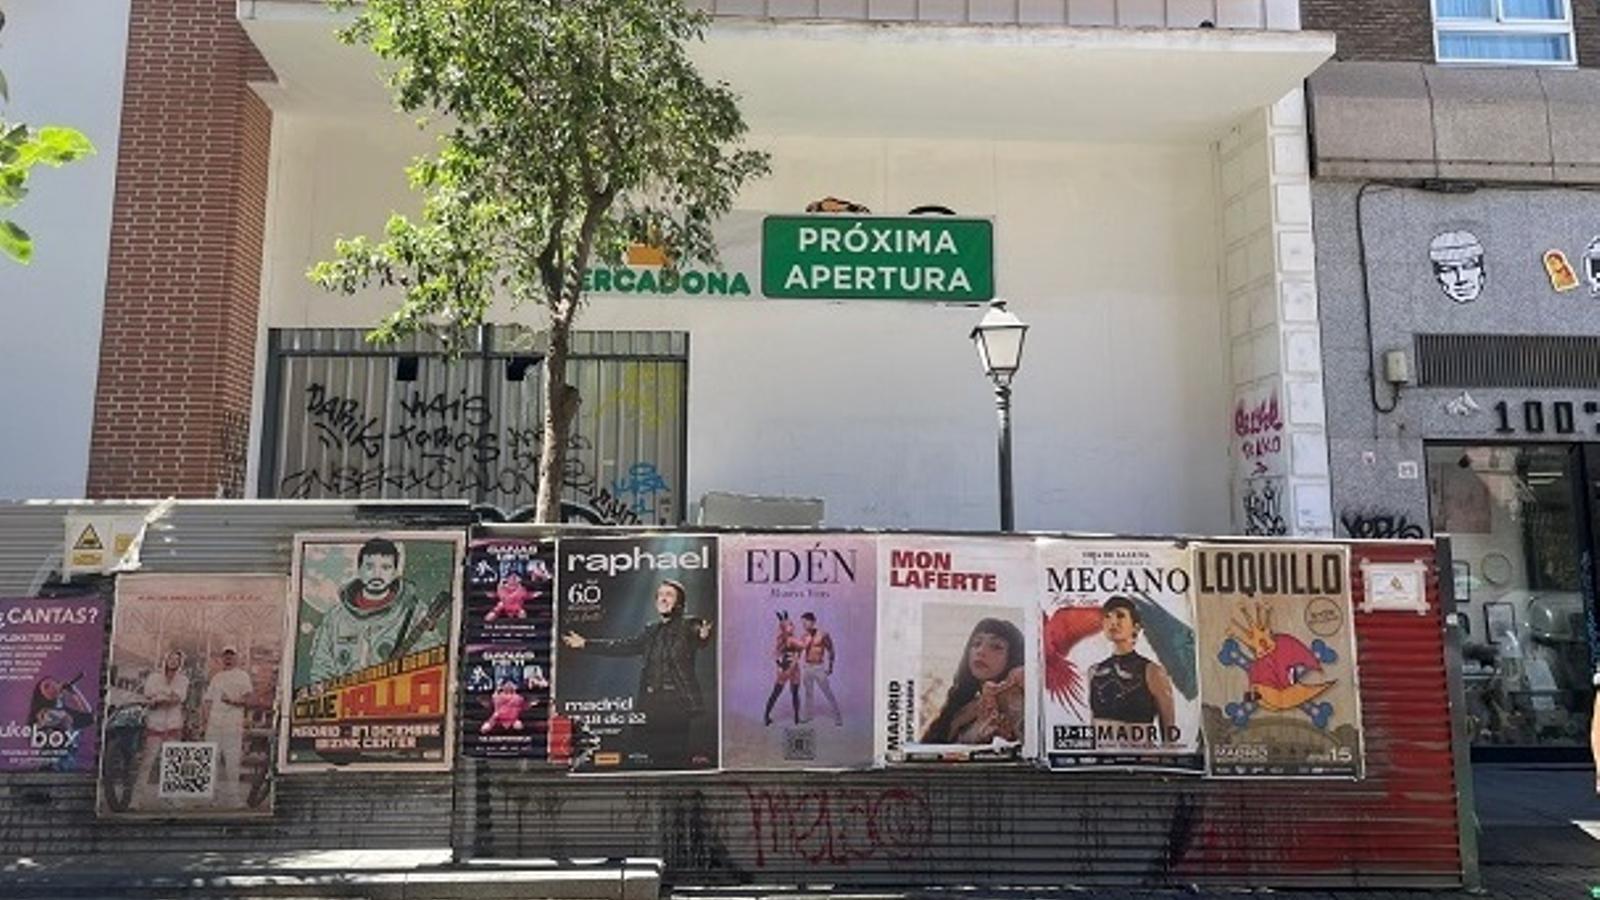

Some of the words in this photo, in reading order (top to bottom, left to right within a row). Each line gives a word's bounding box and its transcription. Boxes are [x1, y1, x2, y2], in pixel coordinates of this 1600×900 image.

[799, 222, 958, 255] PRÓXIMA
[579, 266, 751, 296] ERCADONA
[784, 264, 972, 292] APERTURA
[567, 545, 710, 577] raphael
[744, 541, 857, 584] EDÉN
[891, 550, 952, 570] MON
[1198, 551, 1343, 597] LOQUILLO
[889, 569, 997, 593] LAFERTE
[1046, 566, 1191, 595] MECANO
[564, 697, 634, 712] madrid
[887, 681, 901, 751] MADRID
[1097, 725, 1182, 743] MADRID
